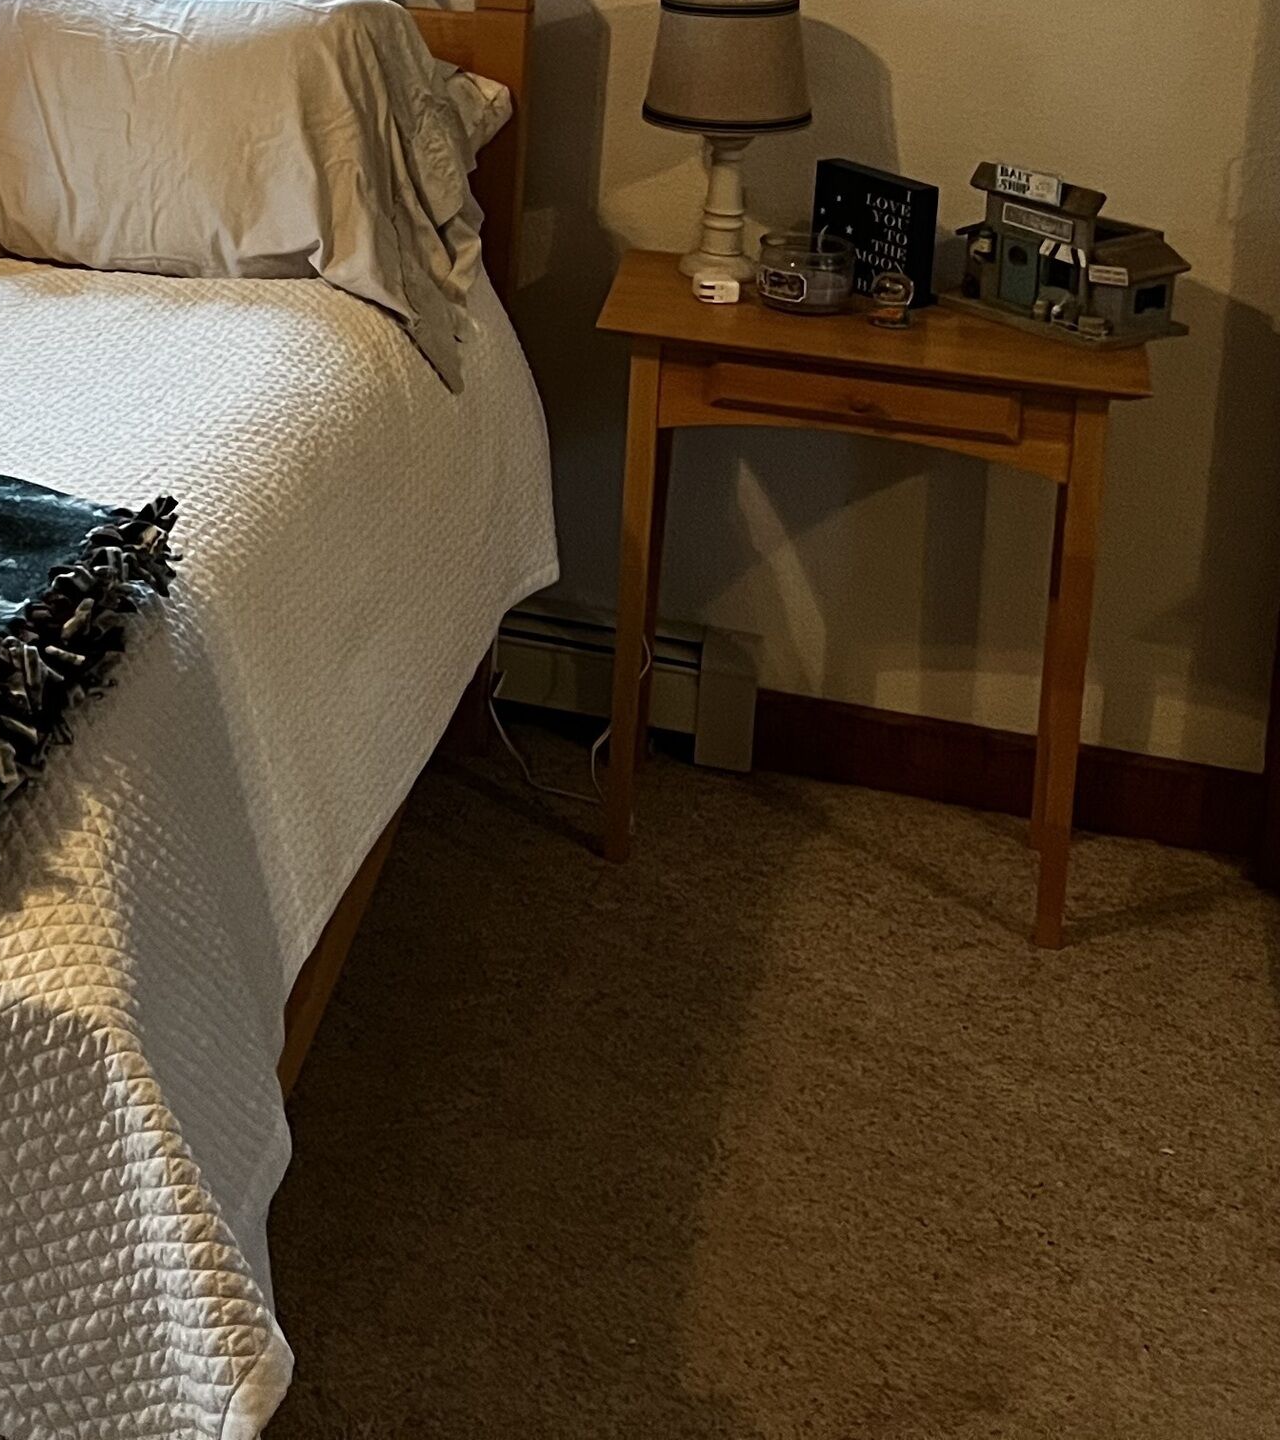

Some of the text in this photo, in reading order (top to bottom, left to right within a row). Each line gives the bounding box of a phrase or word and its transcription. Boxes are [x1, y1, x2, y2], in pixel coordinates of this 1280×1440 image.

[1000, 166, 1032, 182] BAIT
[865, 192, 911, 217] LOVE
[906, 190, 912, 203] I
[872, 209, 910, 230] YOU
[883, 227, 907, 246] TO
[871, 238, 907, 261] THE
[854, 248, 906, 274] MOON
